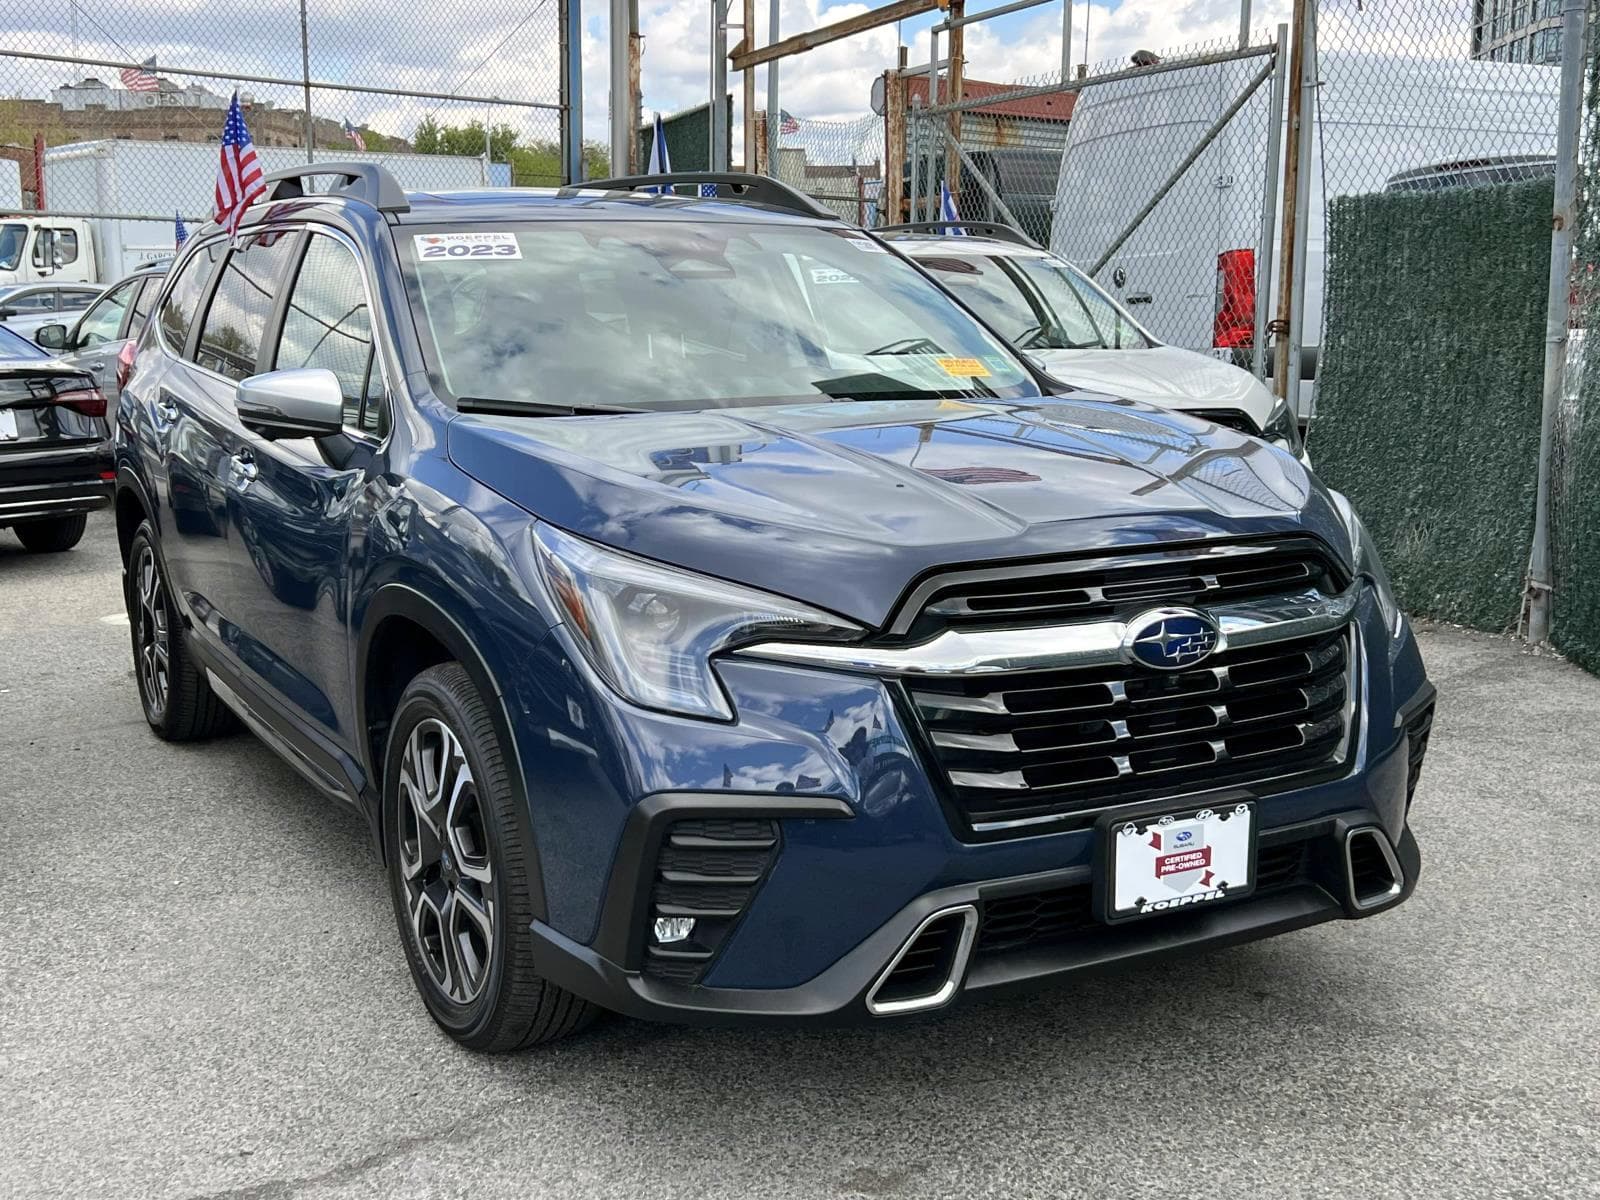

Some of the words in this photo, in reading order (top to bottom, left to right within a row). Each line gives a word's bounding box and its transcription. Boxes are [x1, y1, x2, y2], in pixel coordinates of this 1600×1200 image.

[424, 244, 516, 257] 2023
[815, 274, 857, 283] 202
[1165, 852, 1202, 864] CERTIFIED
[1161, 859, 1206, 872] PRE-OWNED
[1140, 890, 1225, 914] KOEPPEL
